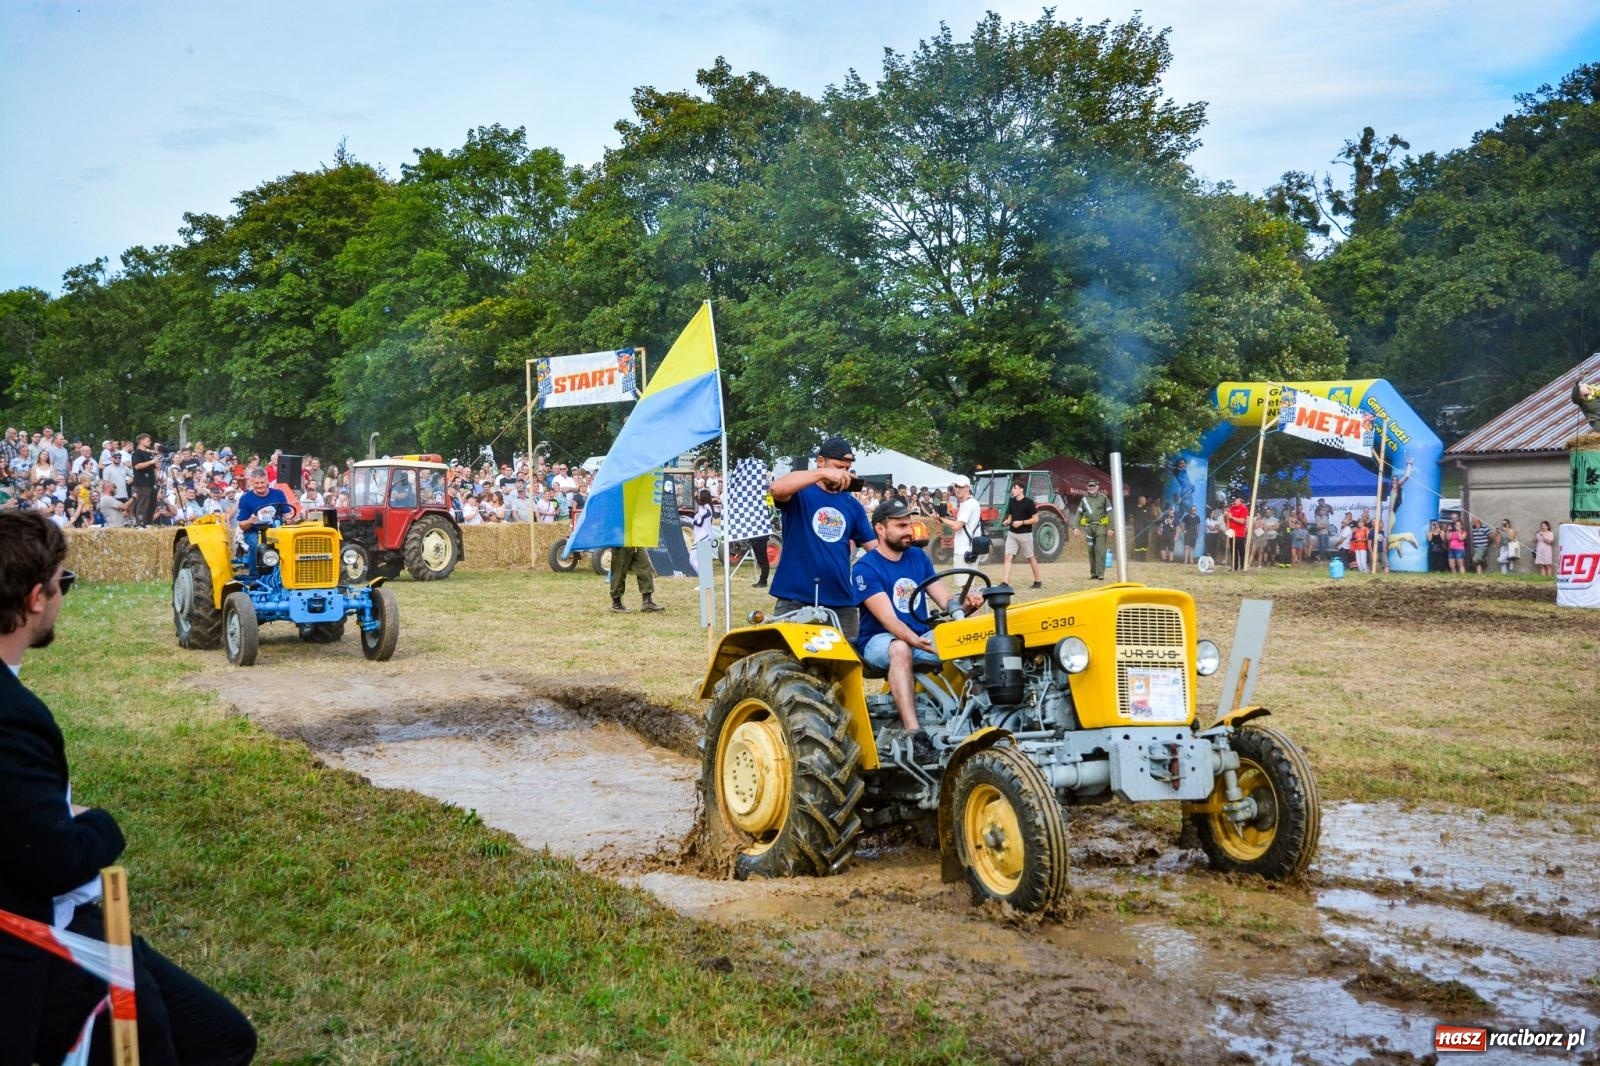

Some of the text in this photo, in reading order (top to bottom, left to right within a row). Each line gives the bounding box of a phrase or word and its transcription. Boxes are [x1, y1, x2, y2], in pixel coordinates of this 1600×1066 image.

[554, 367, 617, 395] START
[1295, 407, 1361, 440] META
[1388, 421, 1411, 444] ludzi
[1041, 616, 1075, 630] C-330
[1122, 649, 1179, 659] URSUS
